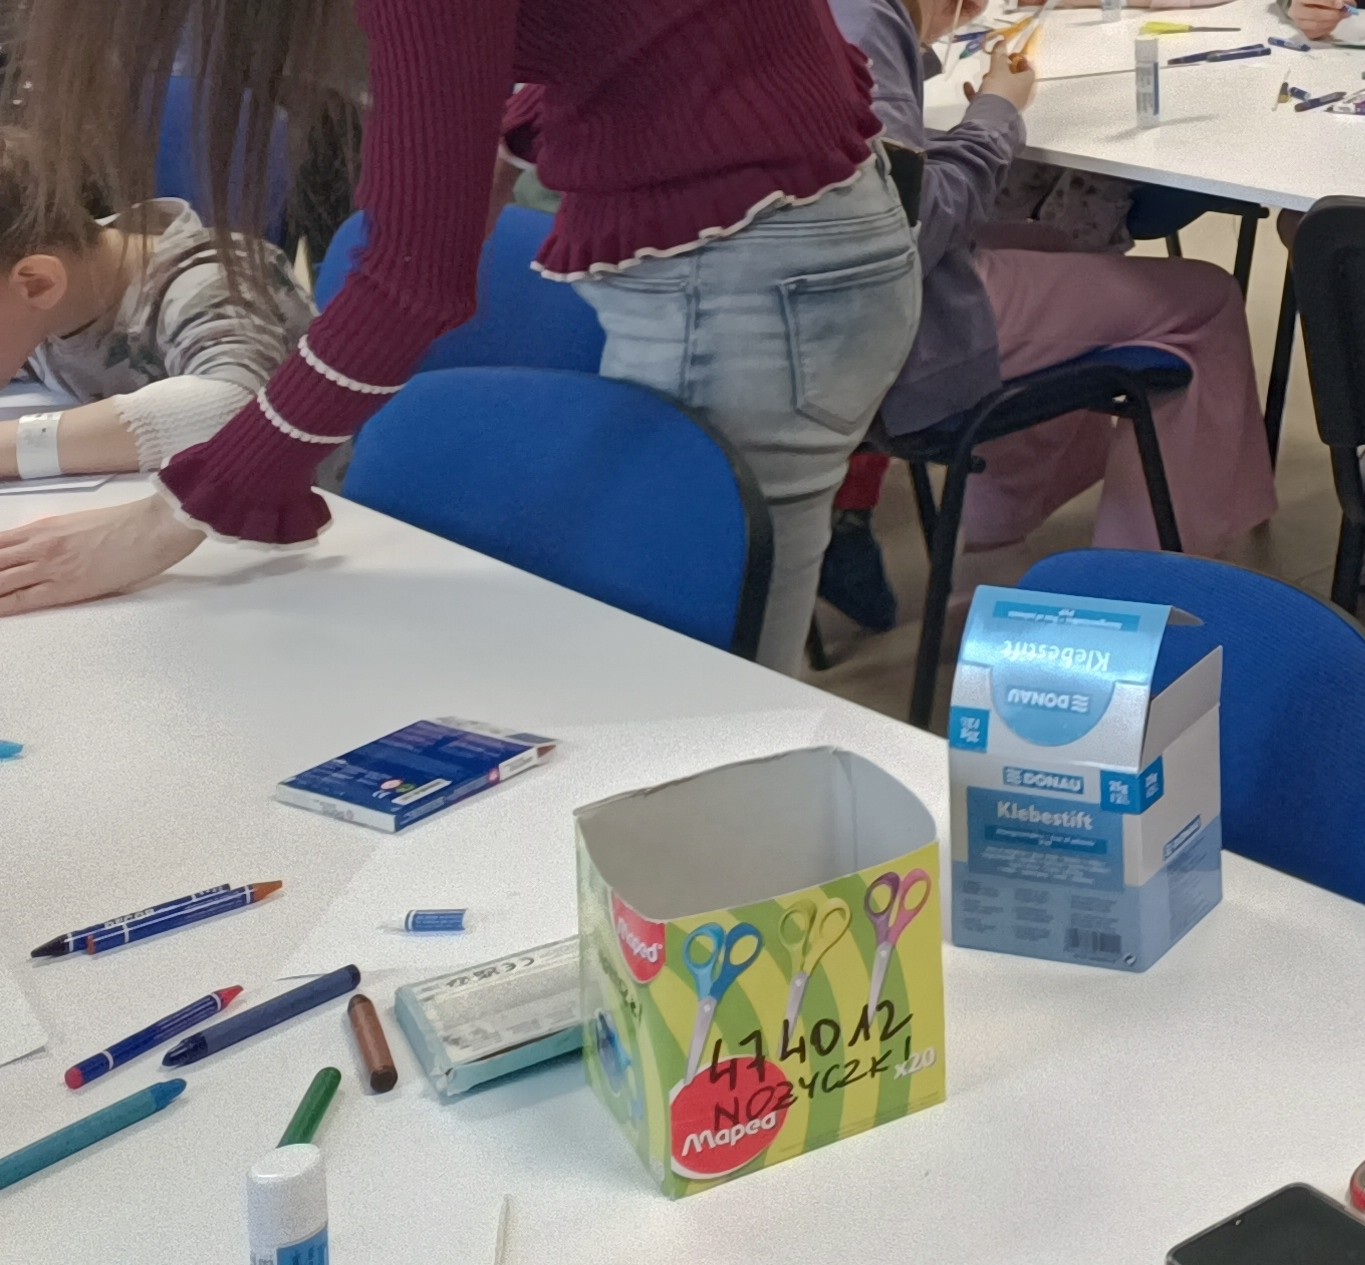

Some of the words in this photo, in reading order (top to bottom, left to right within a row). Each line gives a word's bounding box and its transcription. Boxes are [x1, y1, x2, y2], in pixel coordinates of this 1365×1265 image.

[1001, 640, 1111, 672] Klebestift
[1007, 688, 1071, 709] DONAU
[1023, 772, 1082, 792] DONAU
[997, 800, 1093, 831] Klebestift
[682, 1112, 777, 1157] Maped
